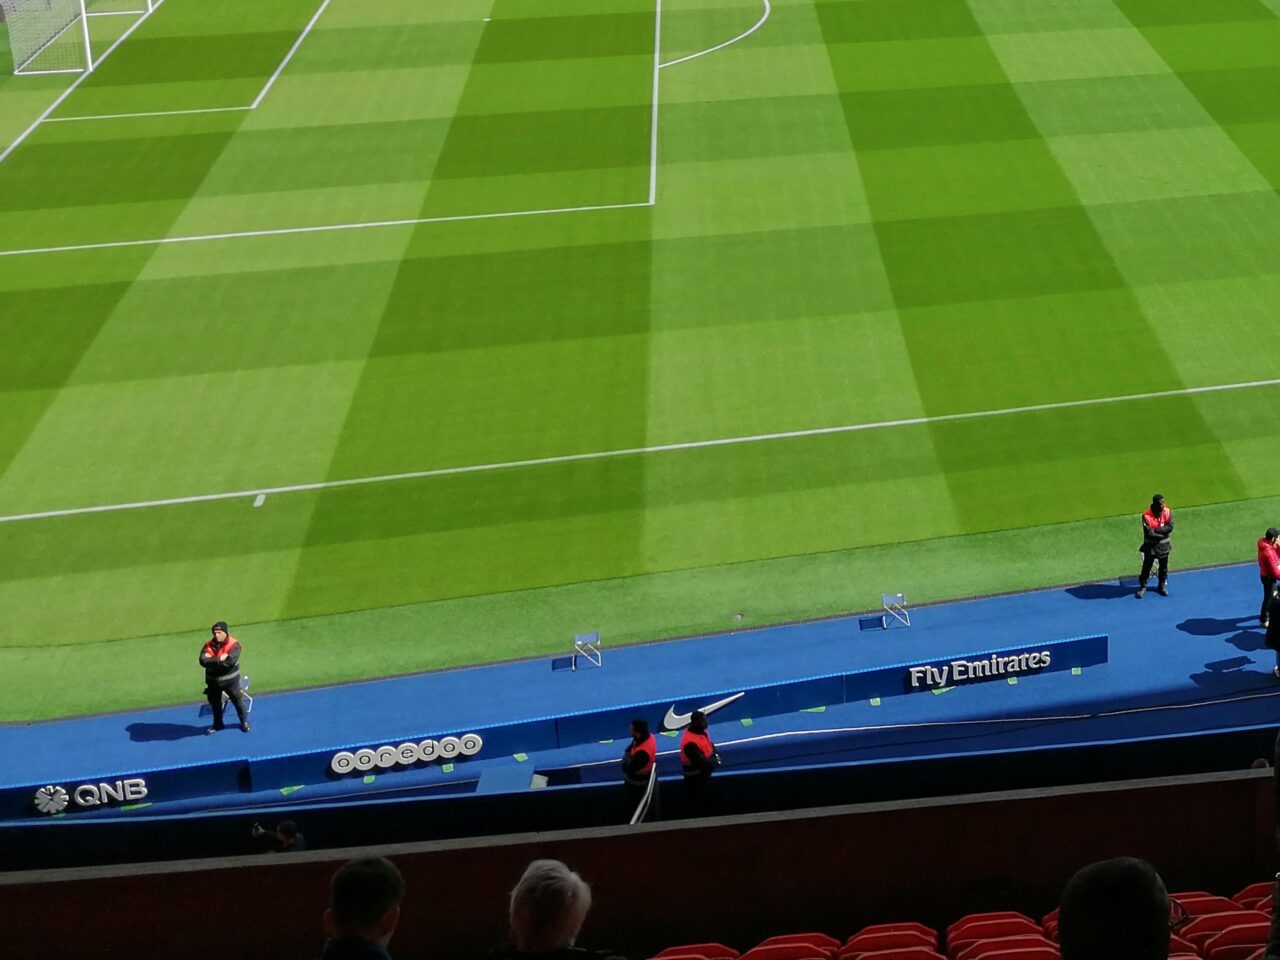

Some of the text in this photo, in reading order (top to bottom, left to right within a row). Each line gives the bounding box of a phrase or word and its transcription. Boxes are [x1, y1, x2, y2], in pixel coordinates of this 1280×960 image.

[910, 650, 1051, 689] Fly Emirates
[331, 733, 482, 774] ooredoo
[73, 778, 148, 808] QNB
